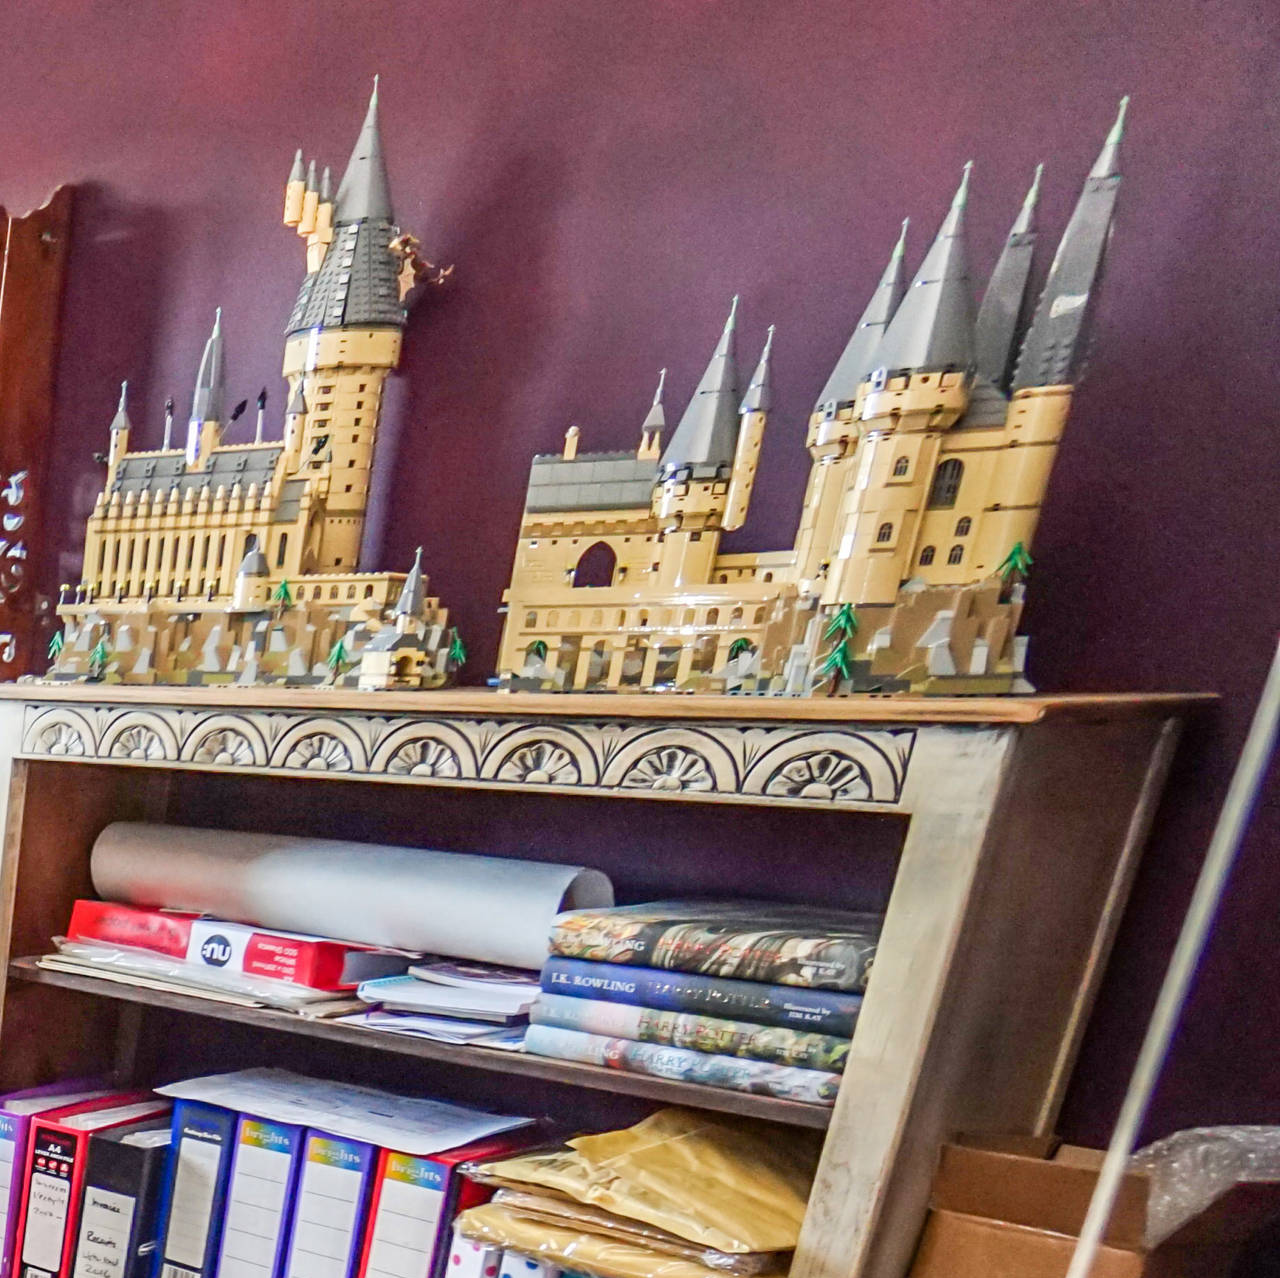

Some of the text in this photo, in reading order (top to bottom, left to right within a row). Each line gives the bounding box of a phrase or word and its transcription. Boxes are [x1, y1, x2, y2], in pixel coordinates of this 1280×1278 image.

[574, 975, 635, 993] ROWLING
[638, 1015, 693, 1036] HARRY
[695, 1024, 756, 1046] POTTER
[631, 1047, 688, 1068] HARRY
[245, 1127, 290, 1146] brights
[48, 1143, 62, 1154] A4
[314, 1144, 361, 1164] brights
[391, 1159, 442, 1183] brights
